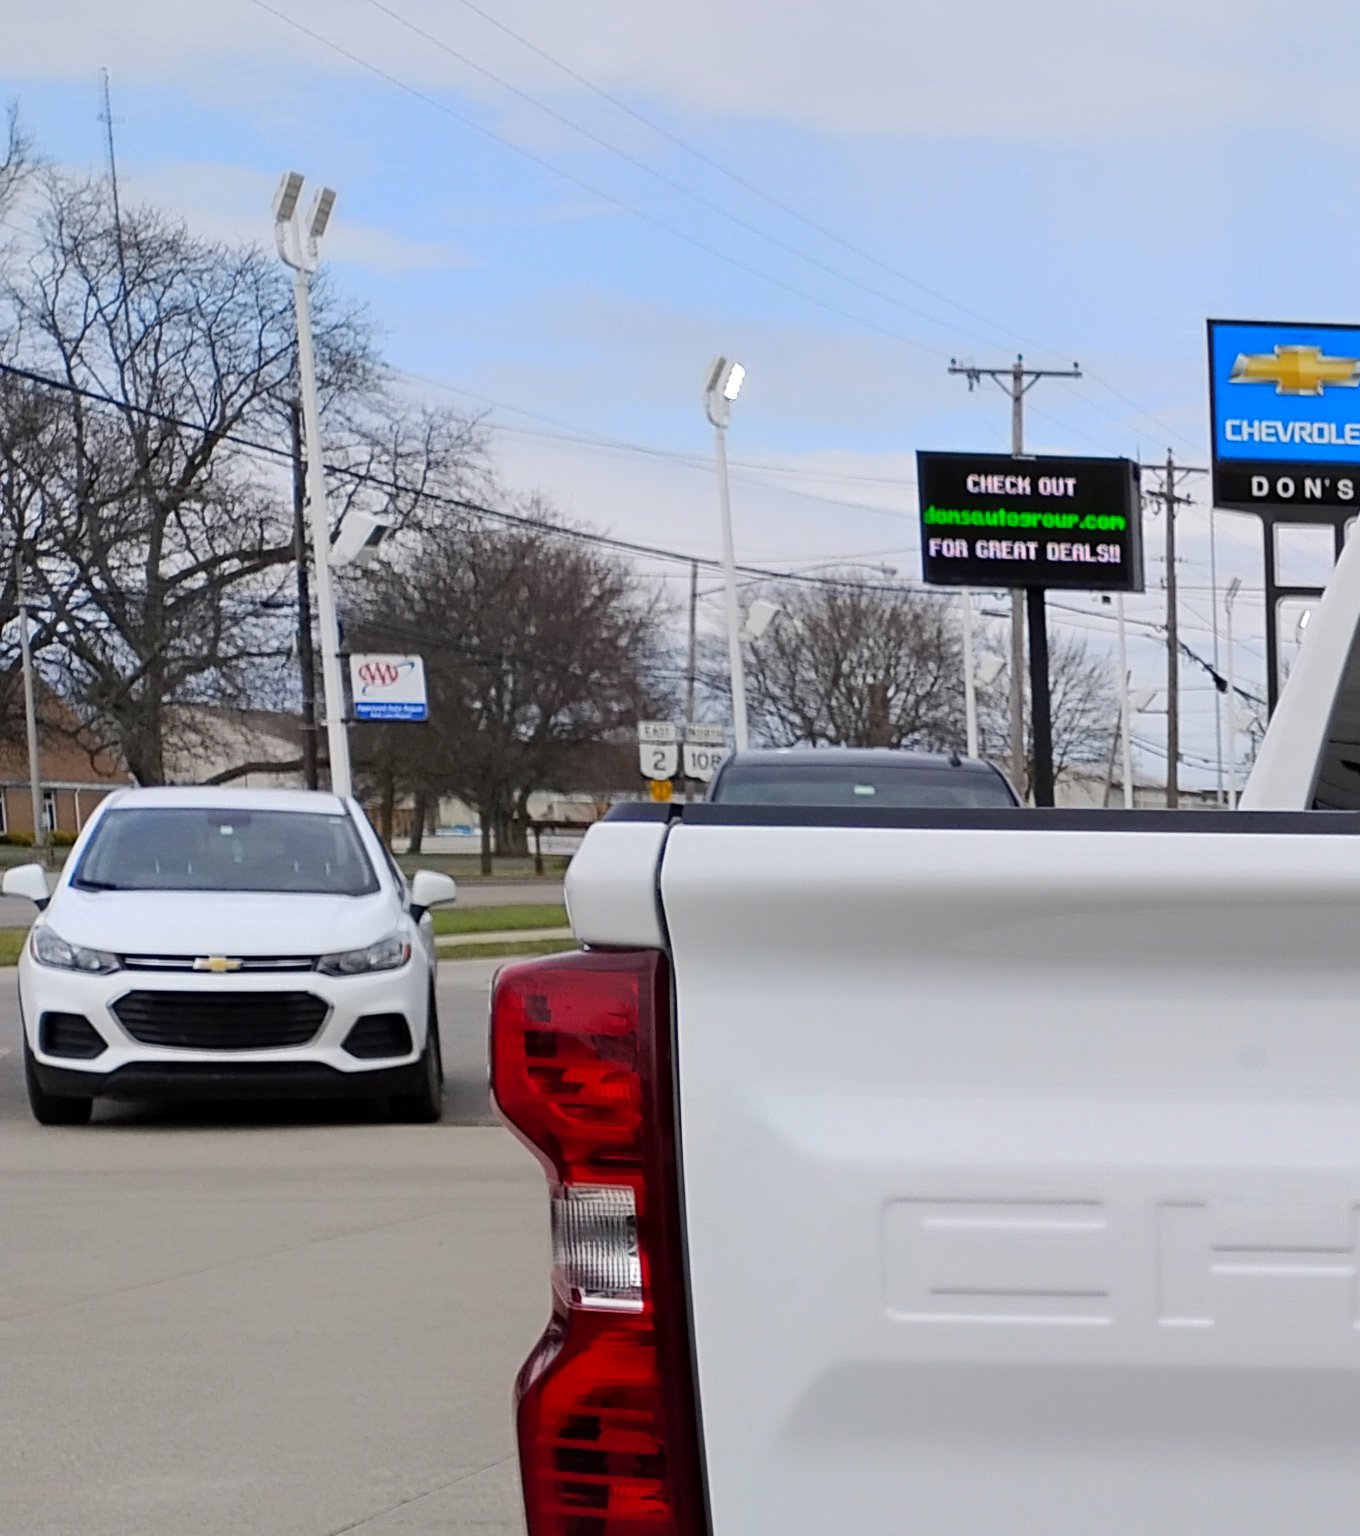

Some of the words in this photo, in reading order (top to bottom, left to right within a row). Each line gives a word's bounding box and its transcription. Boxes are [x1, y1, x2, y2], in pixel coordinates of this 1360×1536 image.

[966, 473, 1031, 496] CHECK
[1038, 476, 1076, 497] OUT
[1251, 475, 1354, 500] DON'S
[928, 537, 968, 559] FOR
[975, 540, 1038, 561] GREAT
[1046, 541, 1121, 564] DEALS!!
[652, 751, 667, 771] 2
